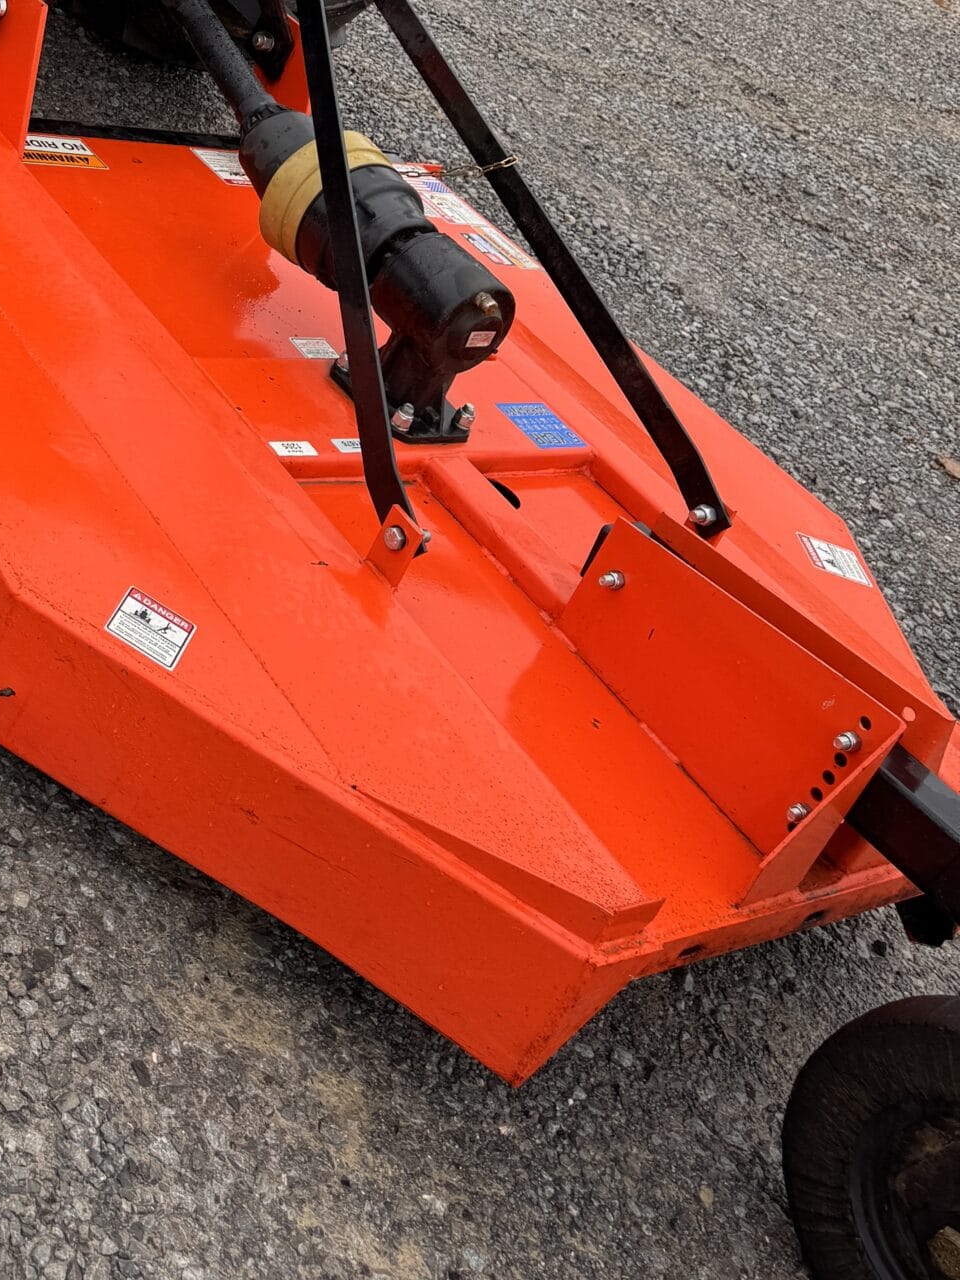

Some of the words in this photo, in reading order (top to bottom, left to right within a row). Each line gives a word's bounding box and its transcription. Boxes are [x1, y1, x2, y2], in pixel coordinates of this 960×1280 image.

[61, 142, 88, 152] NO
[23, 152, 80, 163] WARNIN
[529, 431, 567, 446] YEAR
[142, 598, 189, 630] DANGER
